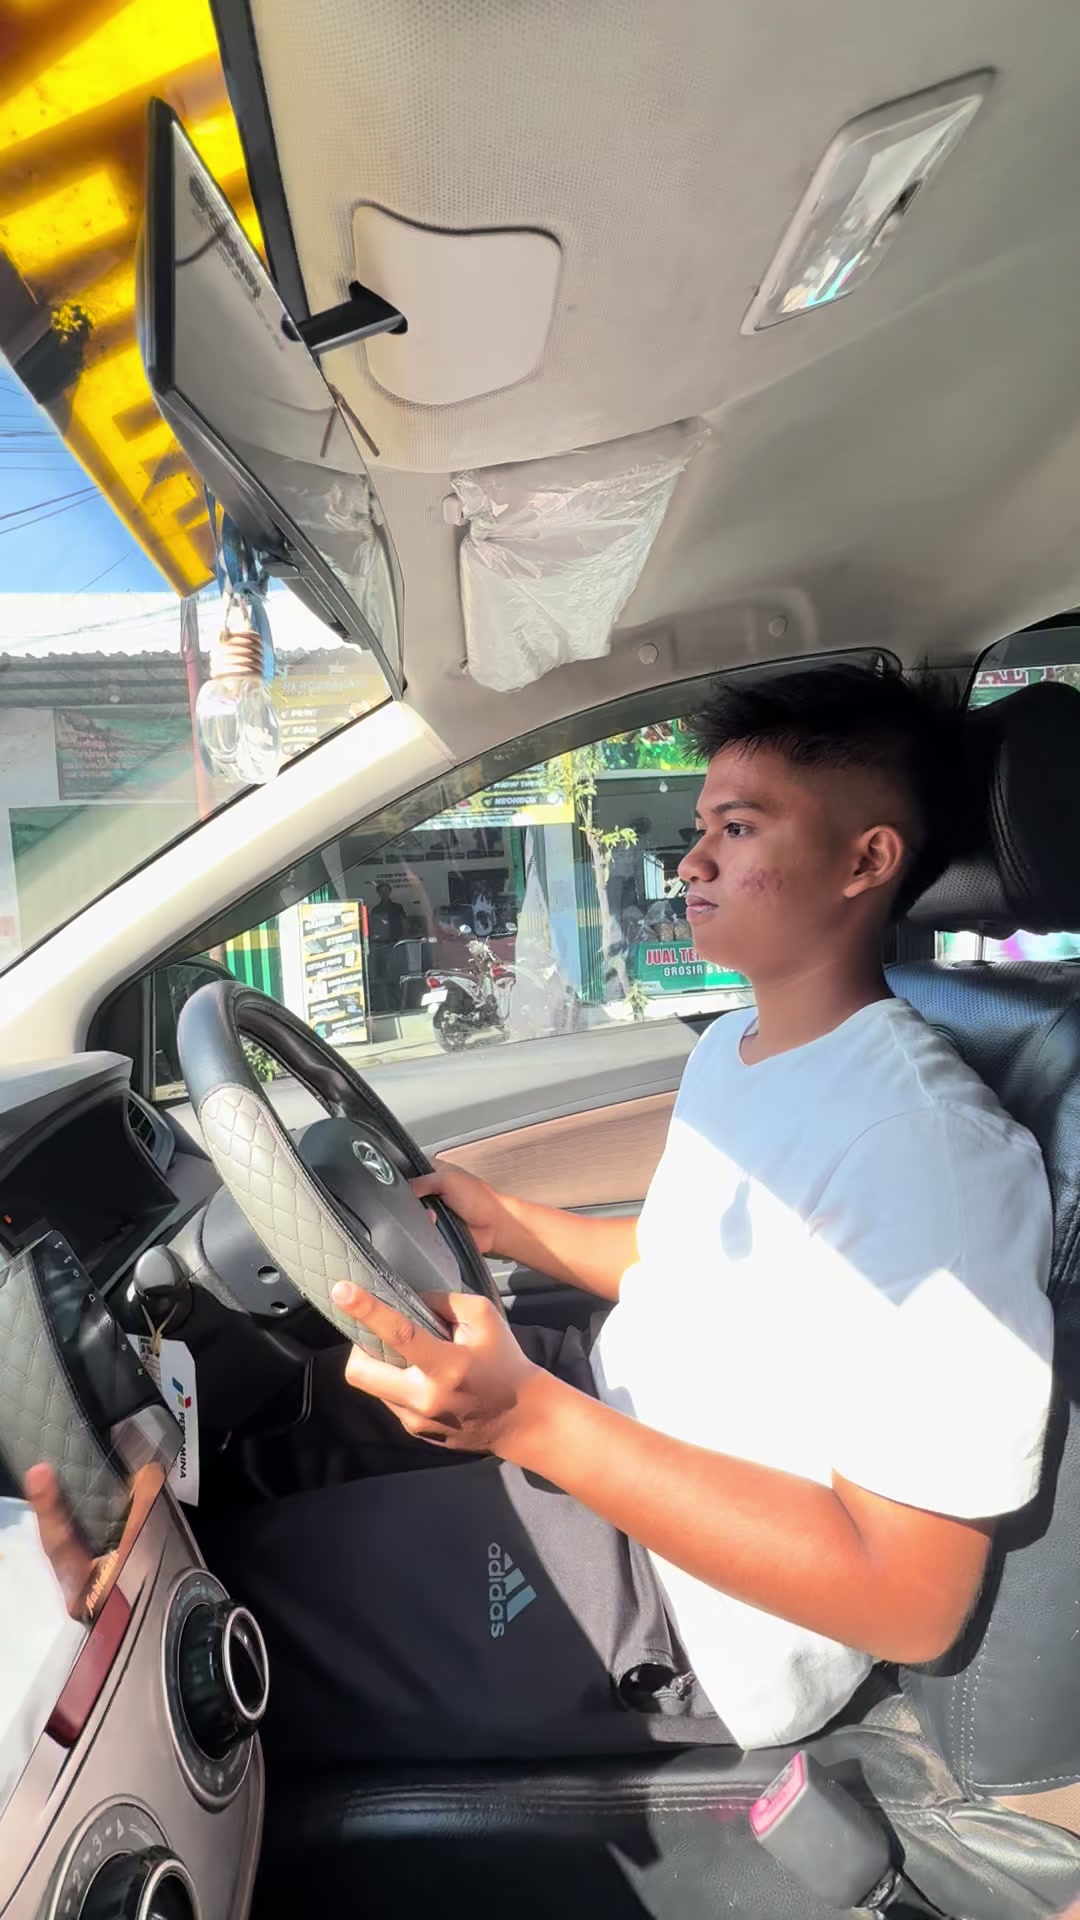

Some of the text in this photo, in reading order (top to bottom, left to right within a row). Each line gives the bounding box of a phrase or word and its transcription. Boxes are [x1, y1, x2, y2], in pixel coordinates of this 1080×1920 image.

[292, 726, 317, 734] SCAN
[646, 948, 677, 965] JUAL
[664, 965, 703, 976] GROSIR
[487, 1542, 507, 1639] adidas
